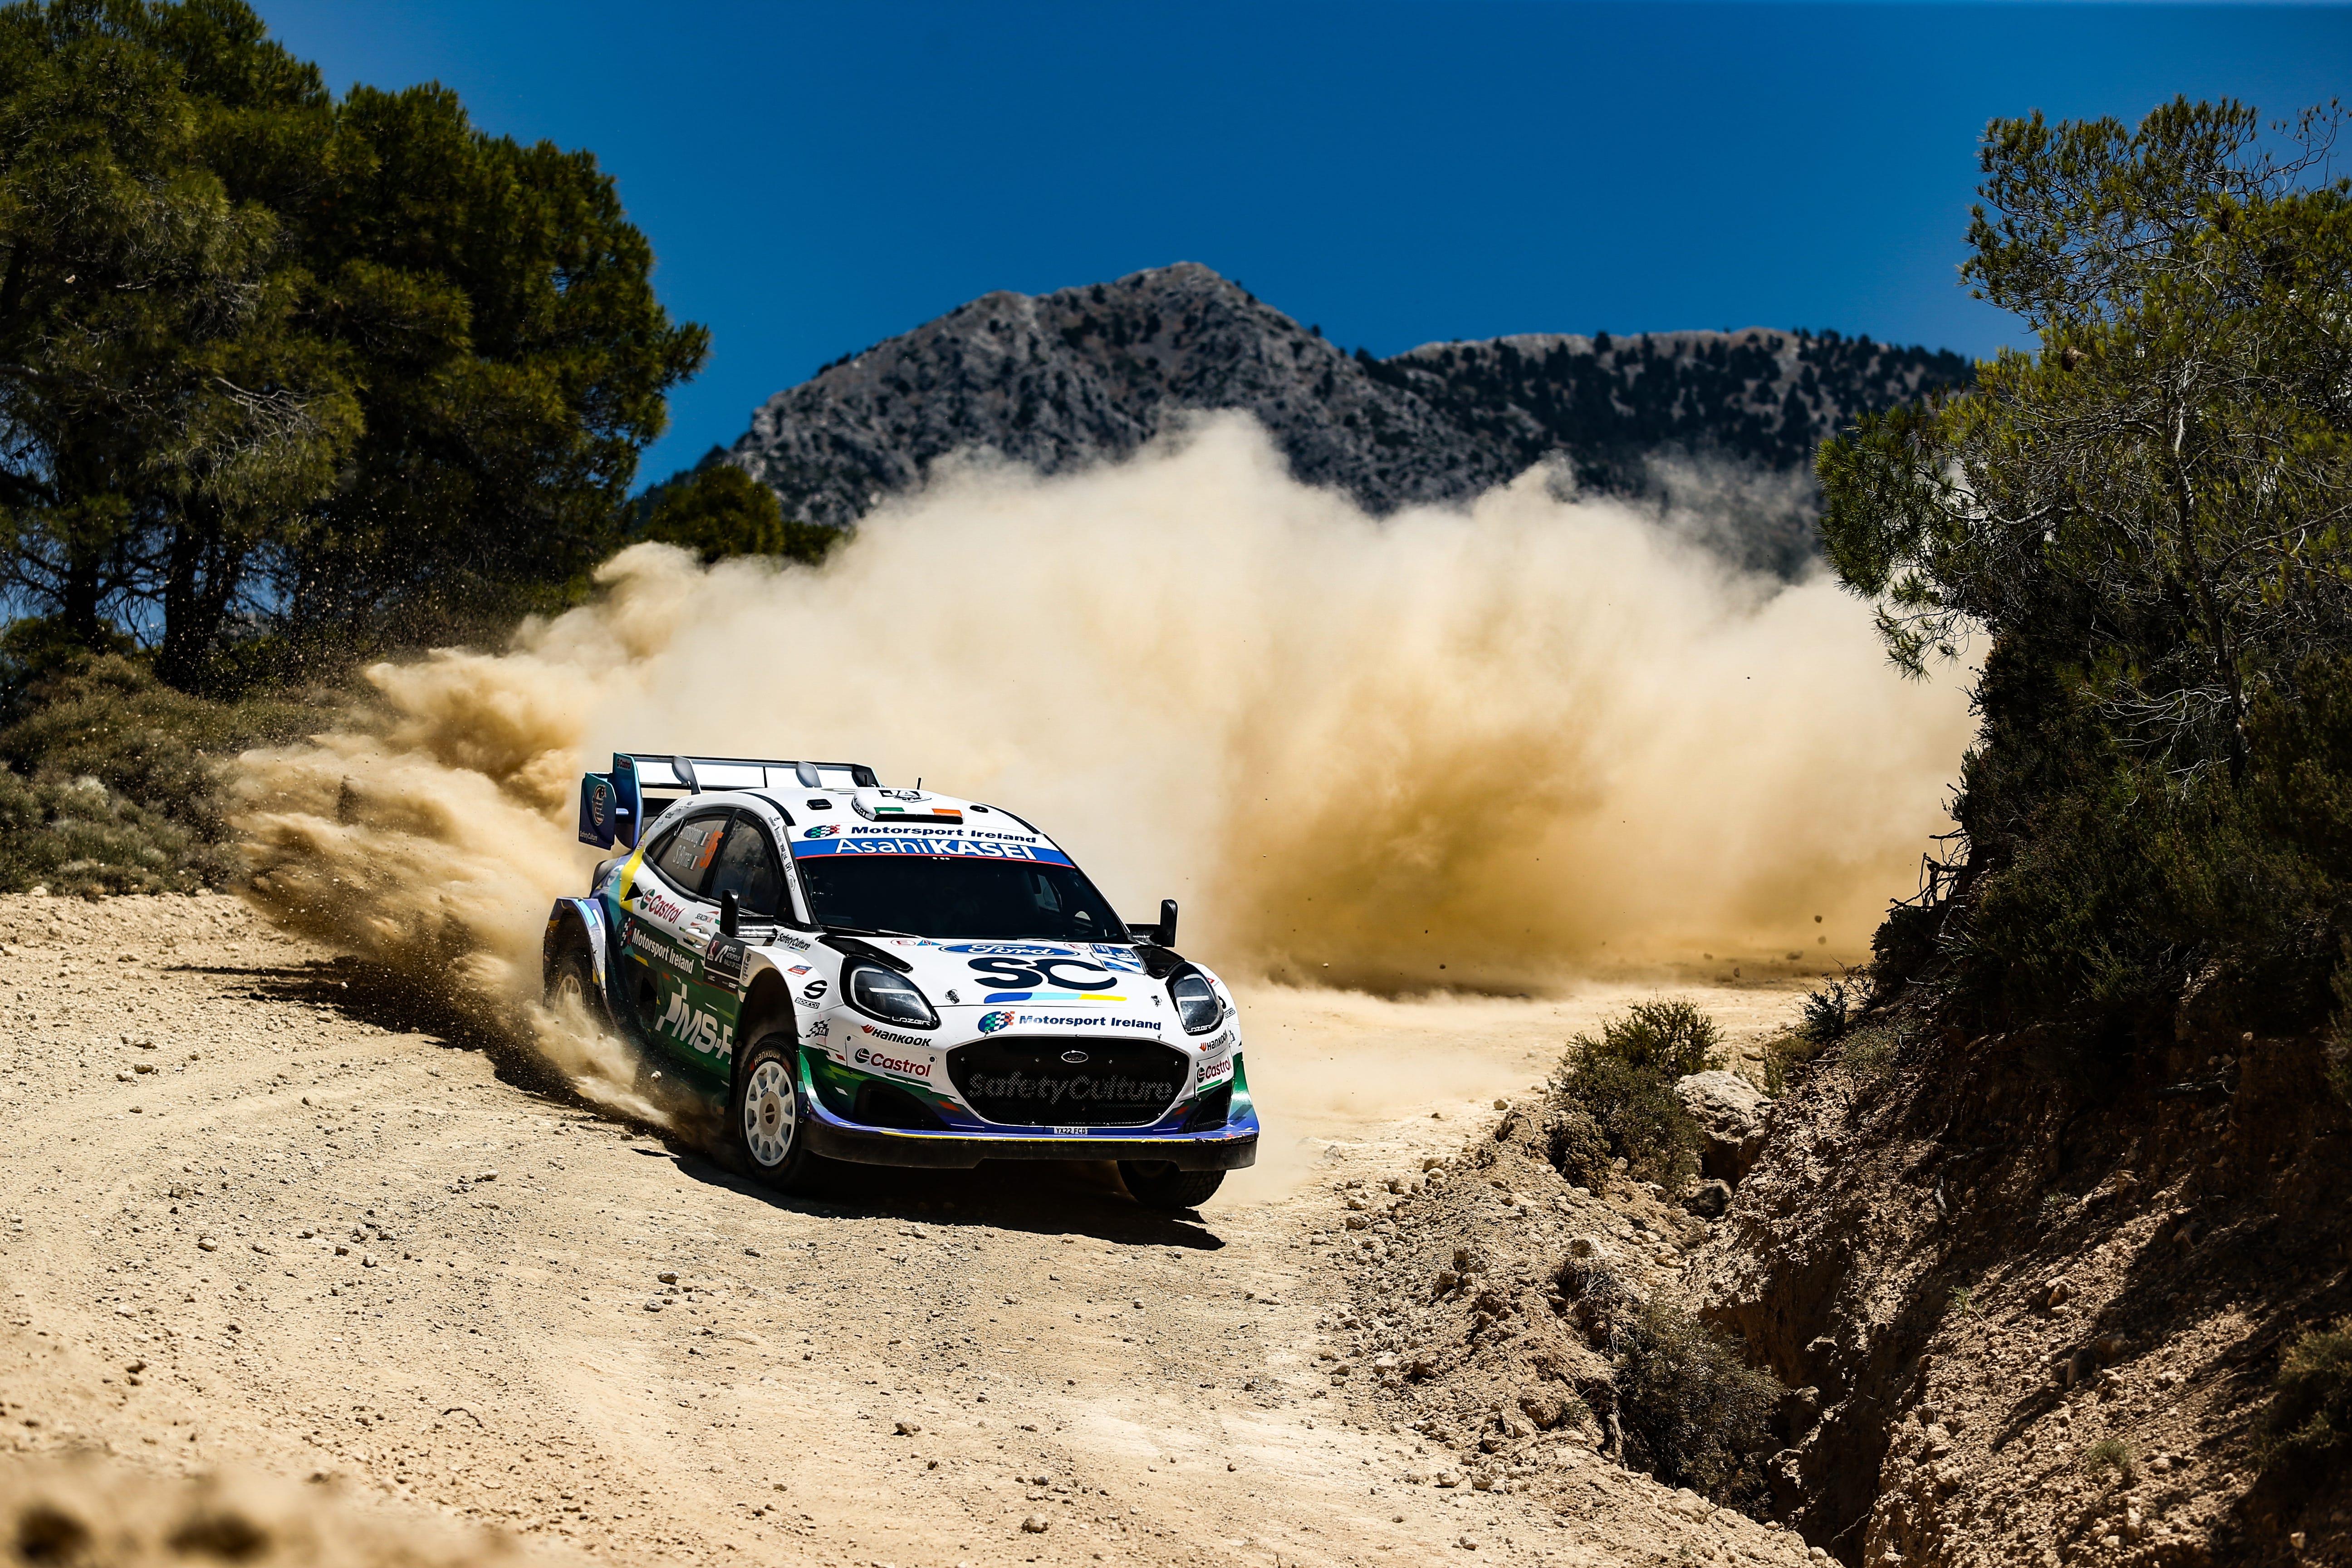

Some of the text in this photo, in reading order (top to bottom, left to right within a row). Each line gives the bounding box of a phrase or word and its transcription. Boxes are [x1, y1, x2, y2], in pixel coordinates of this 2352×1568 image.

[851, 826, 1036, 843] Motorsport Ireland
[648, 895, 686, 924] Castrol
[632, 927, 695, 974] Motorsport Ireland
[777, 933, 811, 950] SafetyCulture
[968, 944, 1056, 956] Ford
[796, 998, 819, 1008] sparco
[1019, 1016, 1161, 1030] Motorsport Ireland
[871, 1053, 931, 1077] Castrol
[1205, 1056, 1232, 1079] Castrol
[968, 1070, 1172, 1104] SafetyCulture
